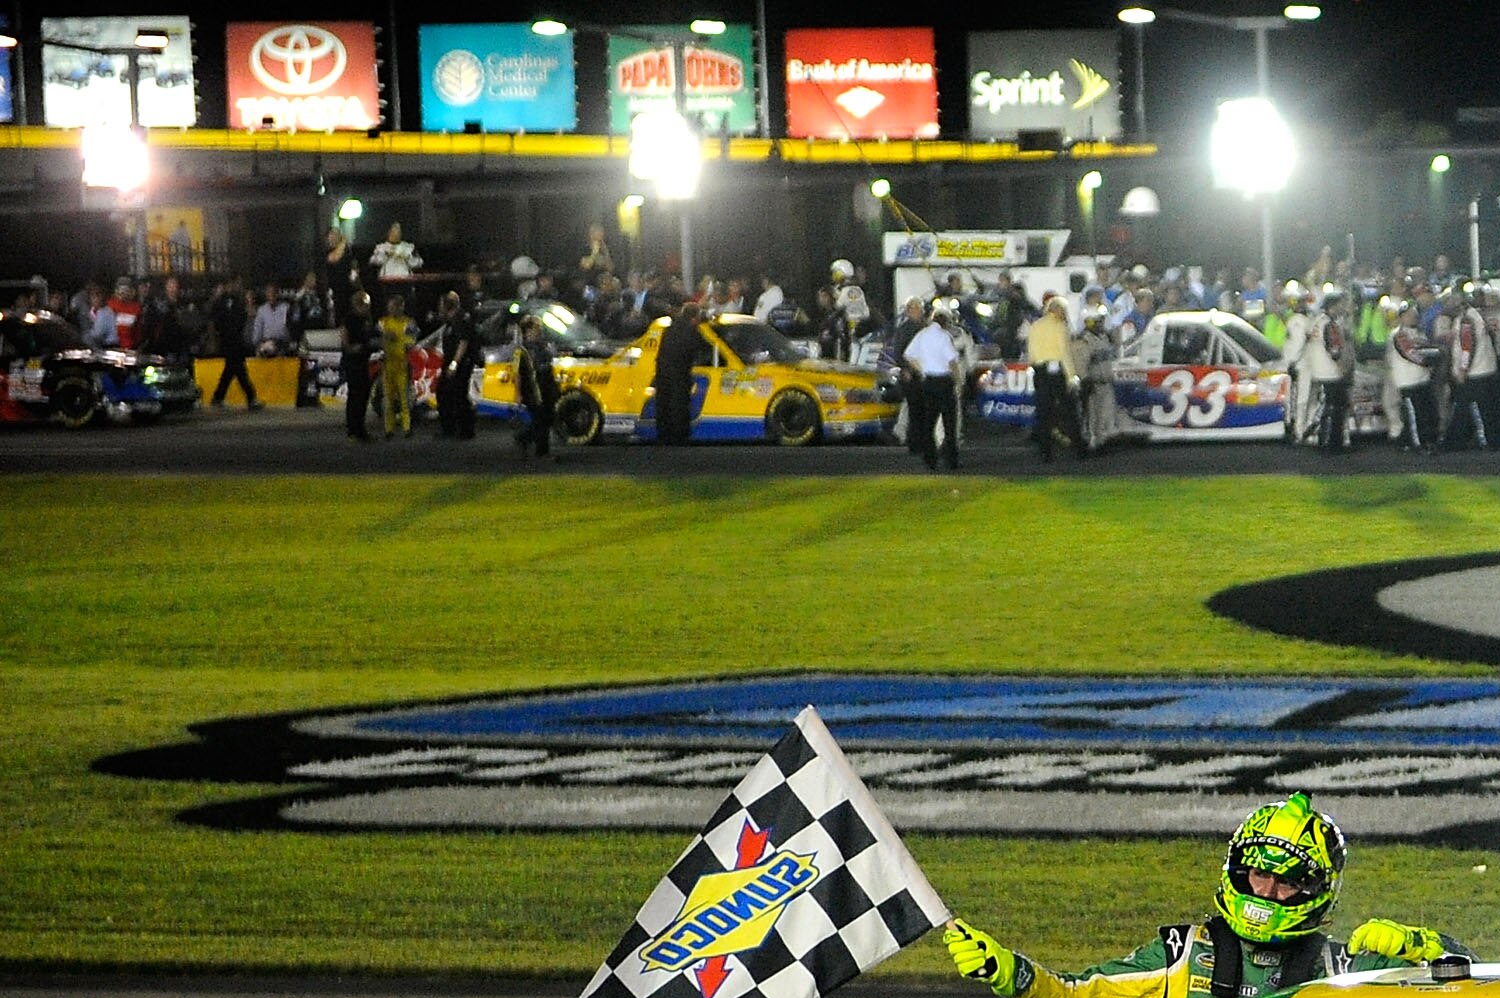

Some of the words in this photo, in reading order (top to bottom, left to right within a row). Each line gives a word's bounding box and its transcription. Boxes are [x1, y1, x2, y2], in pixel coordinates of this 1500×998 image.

[485, 53, 559, 68] Carolinas
[619, 51, 673, 90] PAPA
[789, 58, 834, 80] Bank
[836, 58, 857, 80] of
[857, 58, 932, 80] America
[486, 69, 548, 84] Medical
[486, 84, 538, 99] Center
[972, 69, 1065, 113] Sprint
[1151, 369, 1232, 427] 33
